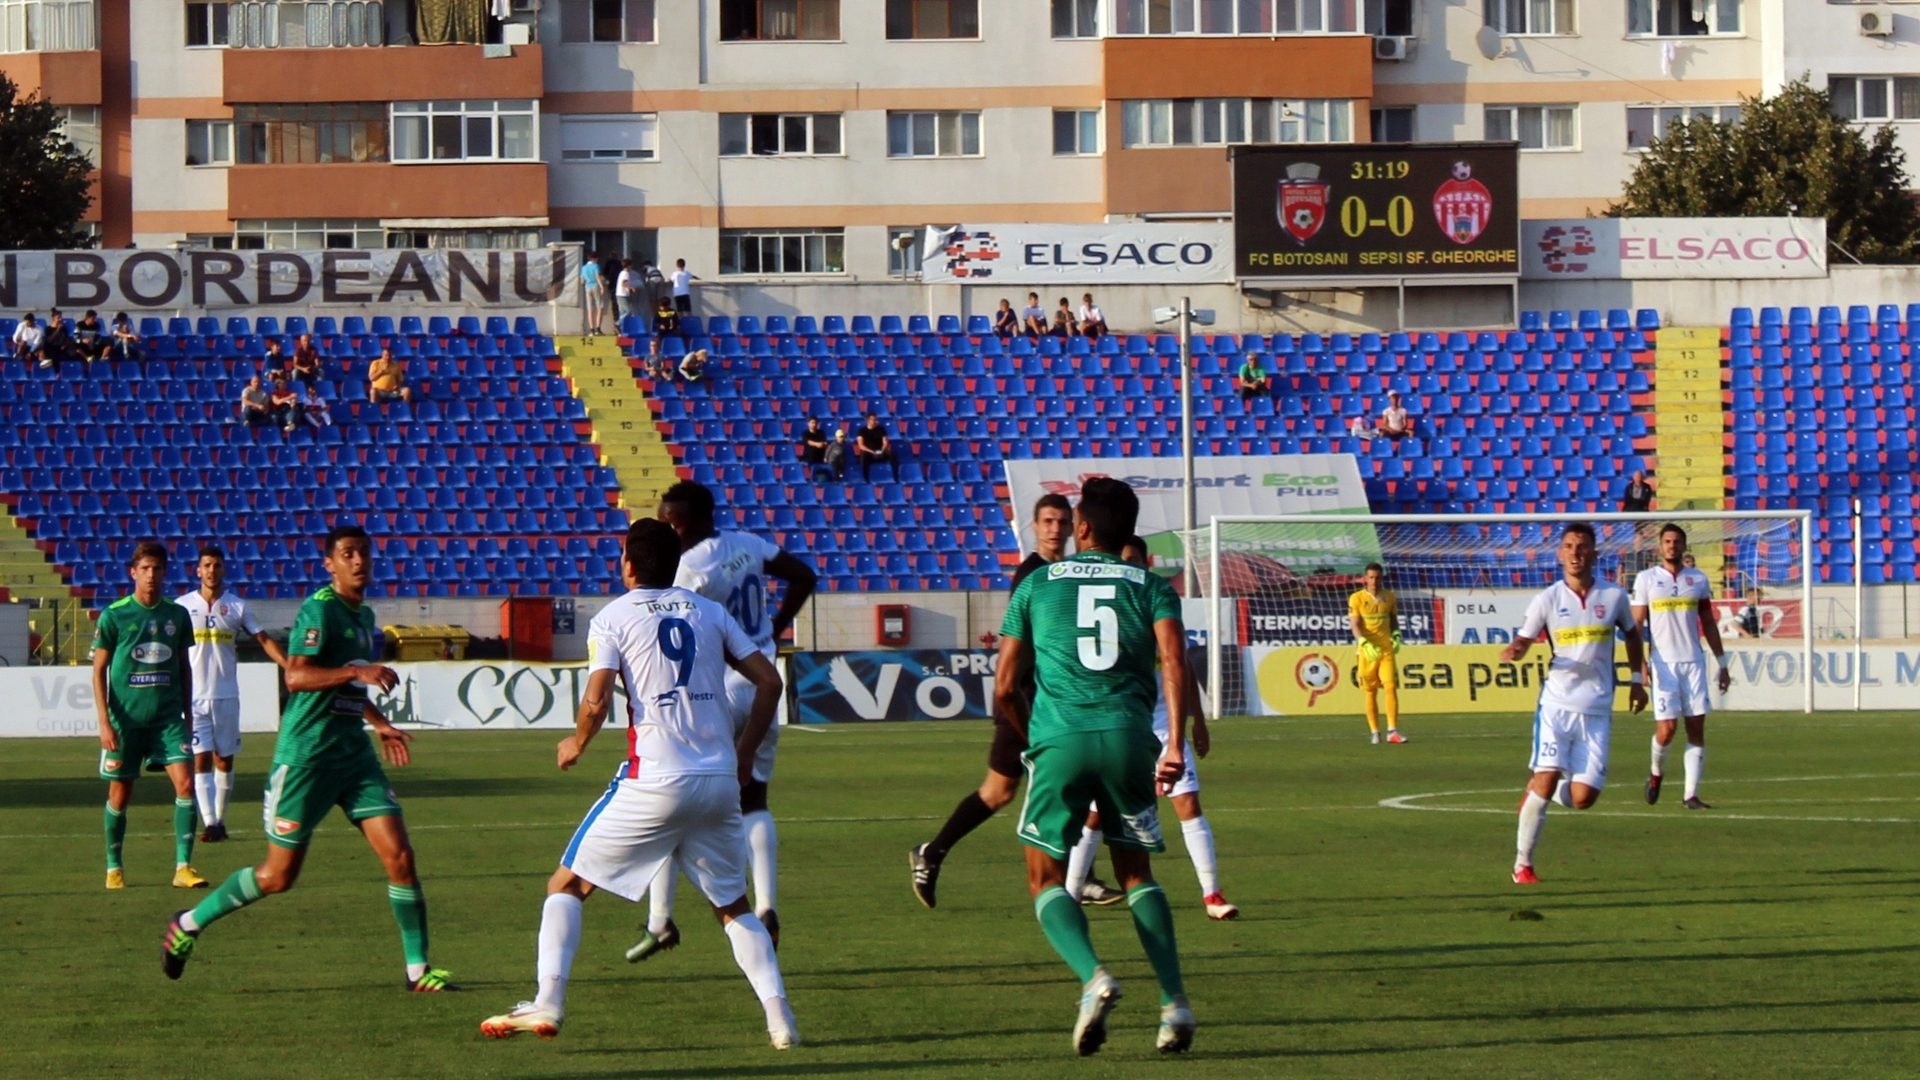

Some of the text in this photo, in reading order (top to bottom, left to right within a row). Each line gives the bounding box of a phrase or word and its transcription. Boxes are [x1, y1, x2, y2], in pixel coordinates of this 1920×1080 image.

[1351, 161, 1410, 179] 31:19
[1341, 195, 1414, 237] 0-0
[1024, 242, 1213, 265] ELSACO
[1619, 237, 1809, 260] ELSACO
[1250, 253, 1348, 265] FC BOTOSANI
[1359, 250, 1516, 264] SEPSI SF. GHEORGHE
[54, 249, 567, 307] BORDEANU
[1681, 351, 1695, 359] 13
[590, 358, 602, 366] 13
[1684, 371, 1699, 379] 12
[600, 379, 614, 387] 12
[1683, 392, 1697, 401] 11
[610, 399, 622, 408] 11
[1684, 415, 1698, 423] 10
[620, 421, 633, 430] 10
[631, 446, 638, 455] 9
[1685, 458, 1692, 467] 8
[1122, 472, 1339, 489] Smart Eco
[1686, 477, 1692, 486] 7
[1276, 486, 1340, 497] Plus
[1457, 604, 1497, 615] DE LA
[205, 615, 216, 628] 15
[1077, 585, 1119, 671] 5
[657, 618, 696, 688] 9
[829, 655, 996, 720] VO
[1659, 698, 1667, 713] 3
[37, 718, 98, 735] Grupu
[1541, 742, 1558, 757] 26
